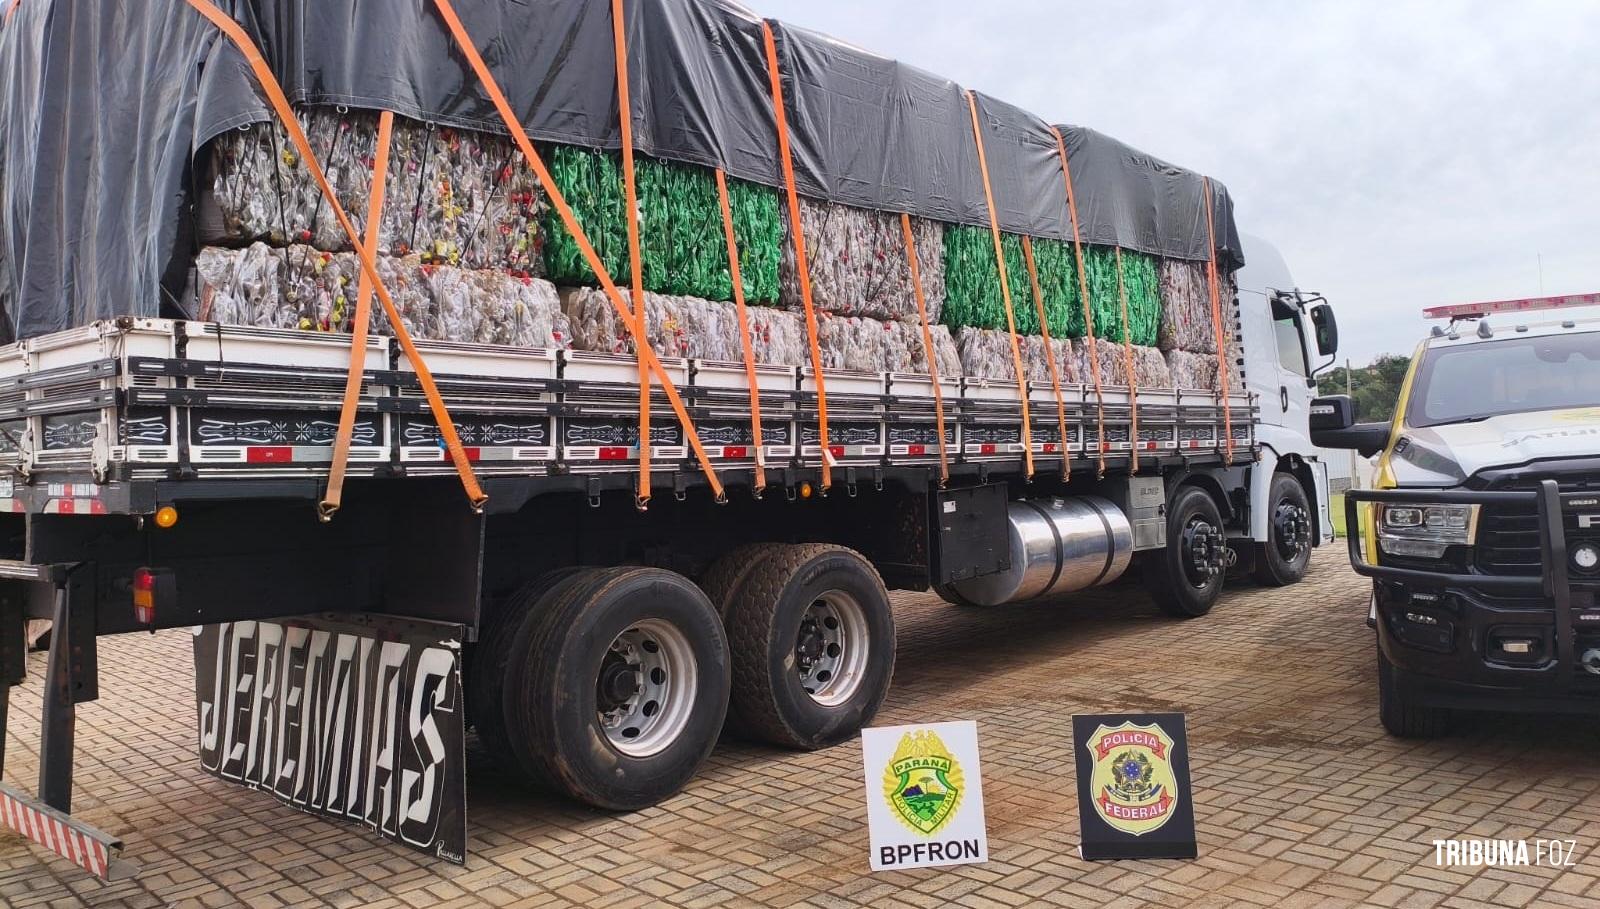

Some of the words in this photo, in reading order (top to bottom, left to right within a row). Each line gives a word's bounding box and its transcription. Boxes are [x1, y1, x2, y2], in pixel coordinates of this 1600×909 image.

[200, 620, 456, 848] JEREMIAS
[930, 792, 955, 825] MILITAR
[1105, 802, 1165, 819] FEDERAL
[880, 839, 980, 865] BPFRON
